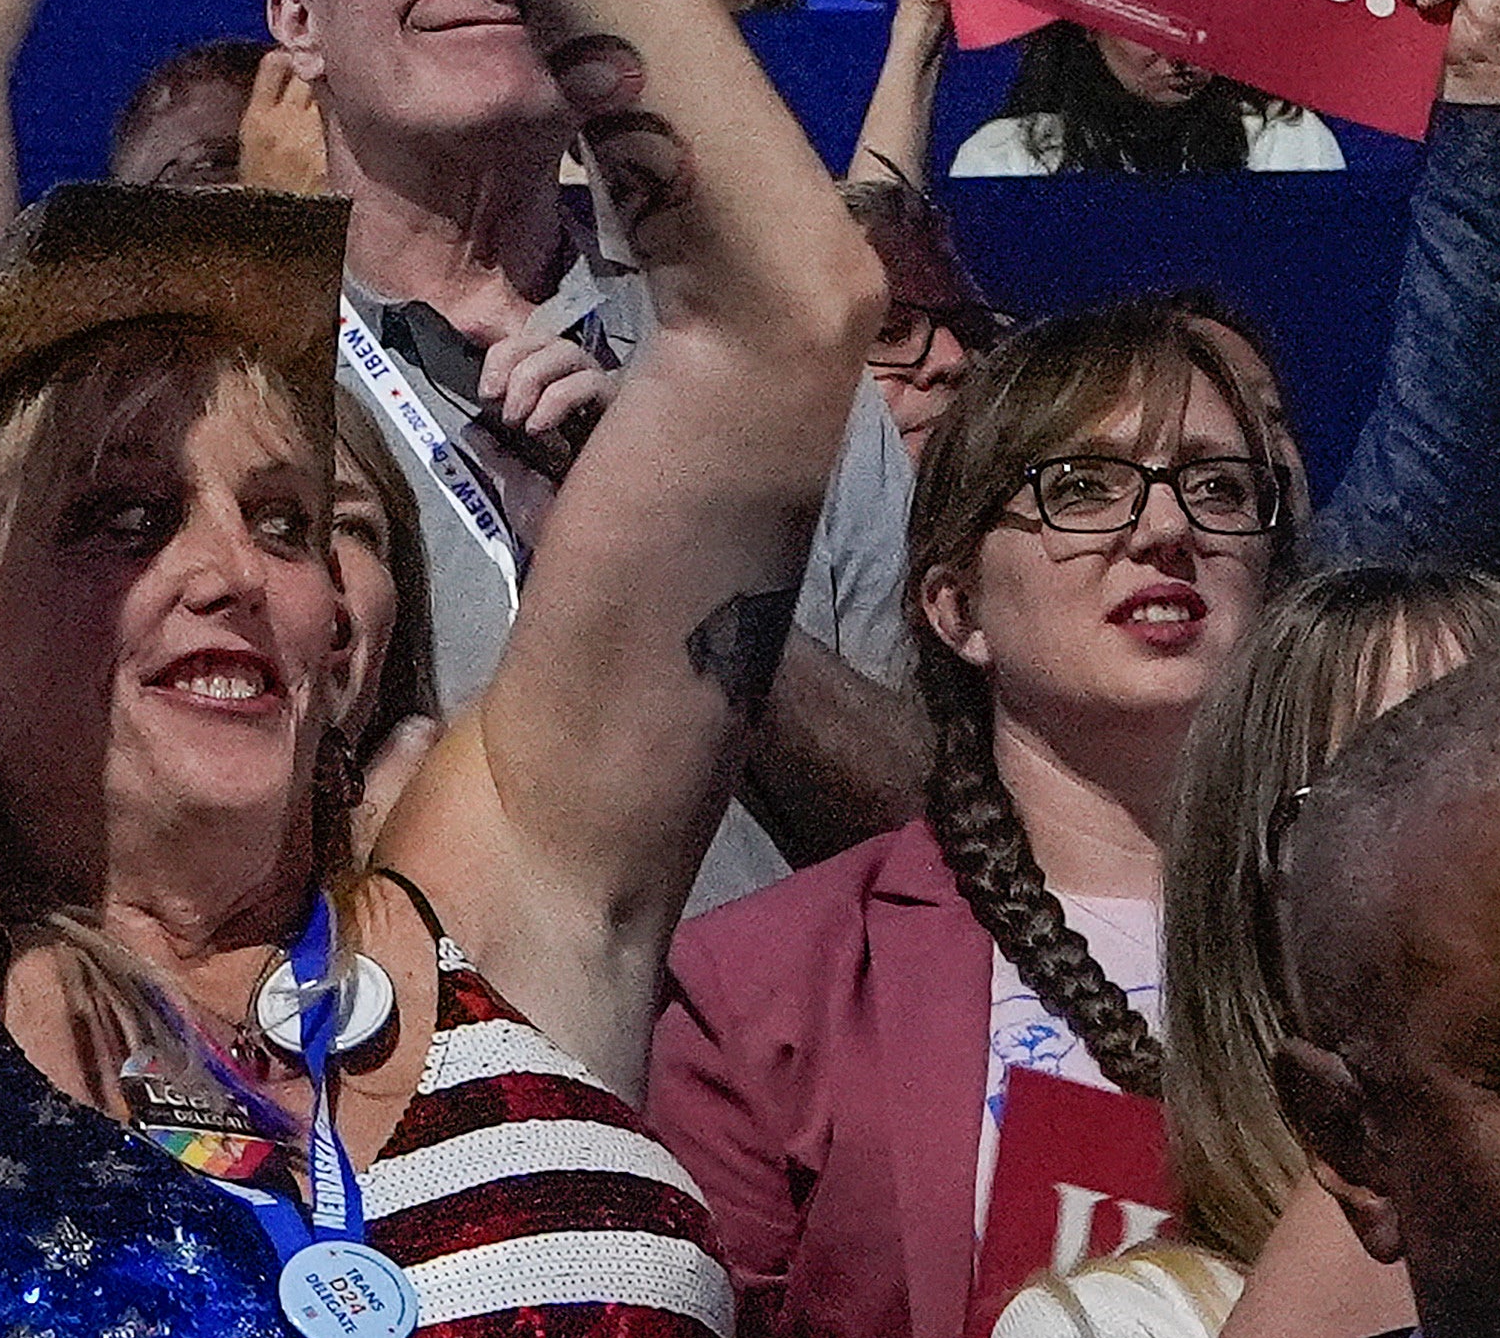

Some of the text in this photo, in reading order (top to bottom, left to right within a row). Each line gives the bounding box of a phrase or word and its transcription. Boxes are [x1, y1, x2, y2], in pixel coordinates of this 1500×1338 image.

[343, 327, 391, 380] IBEW
[452, 479, 502, 541] IBEW
[305, 1272, 359, 1335] DELEGATE
[345, 1267, 386, 1313] TRANS
